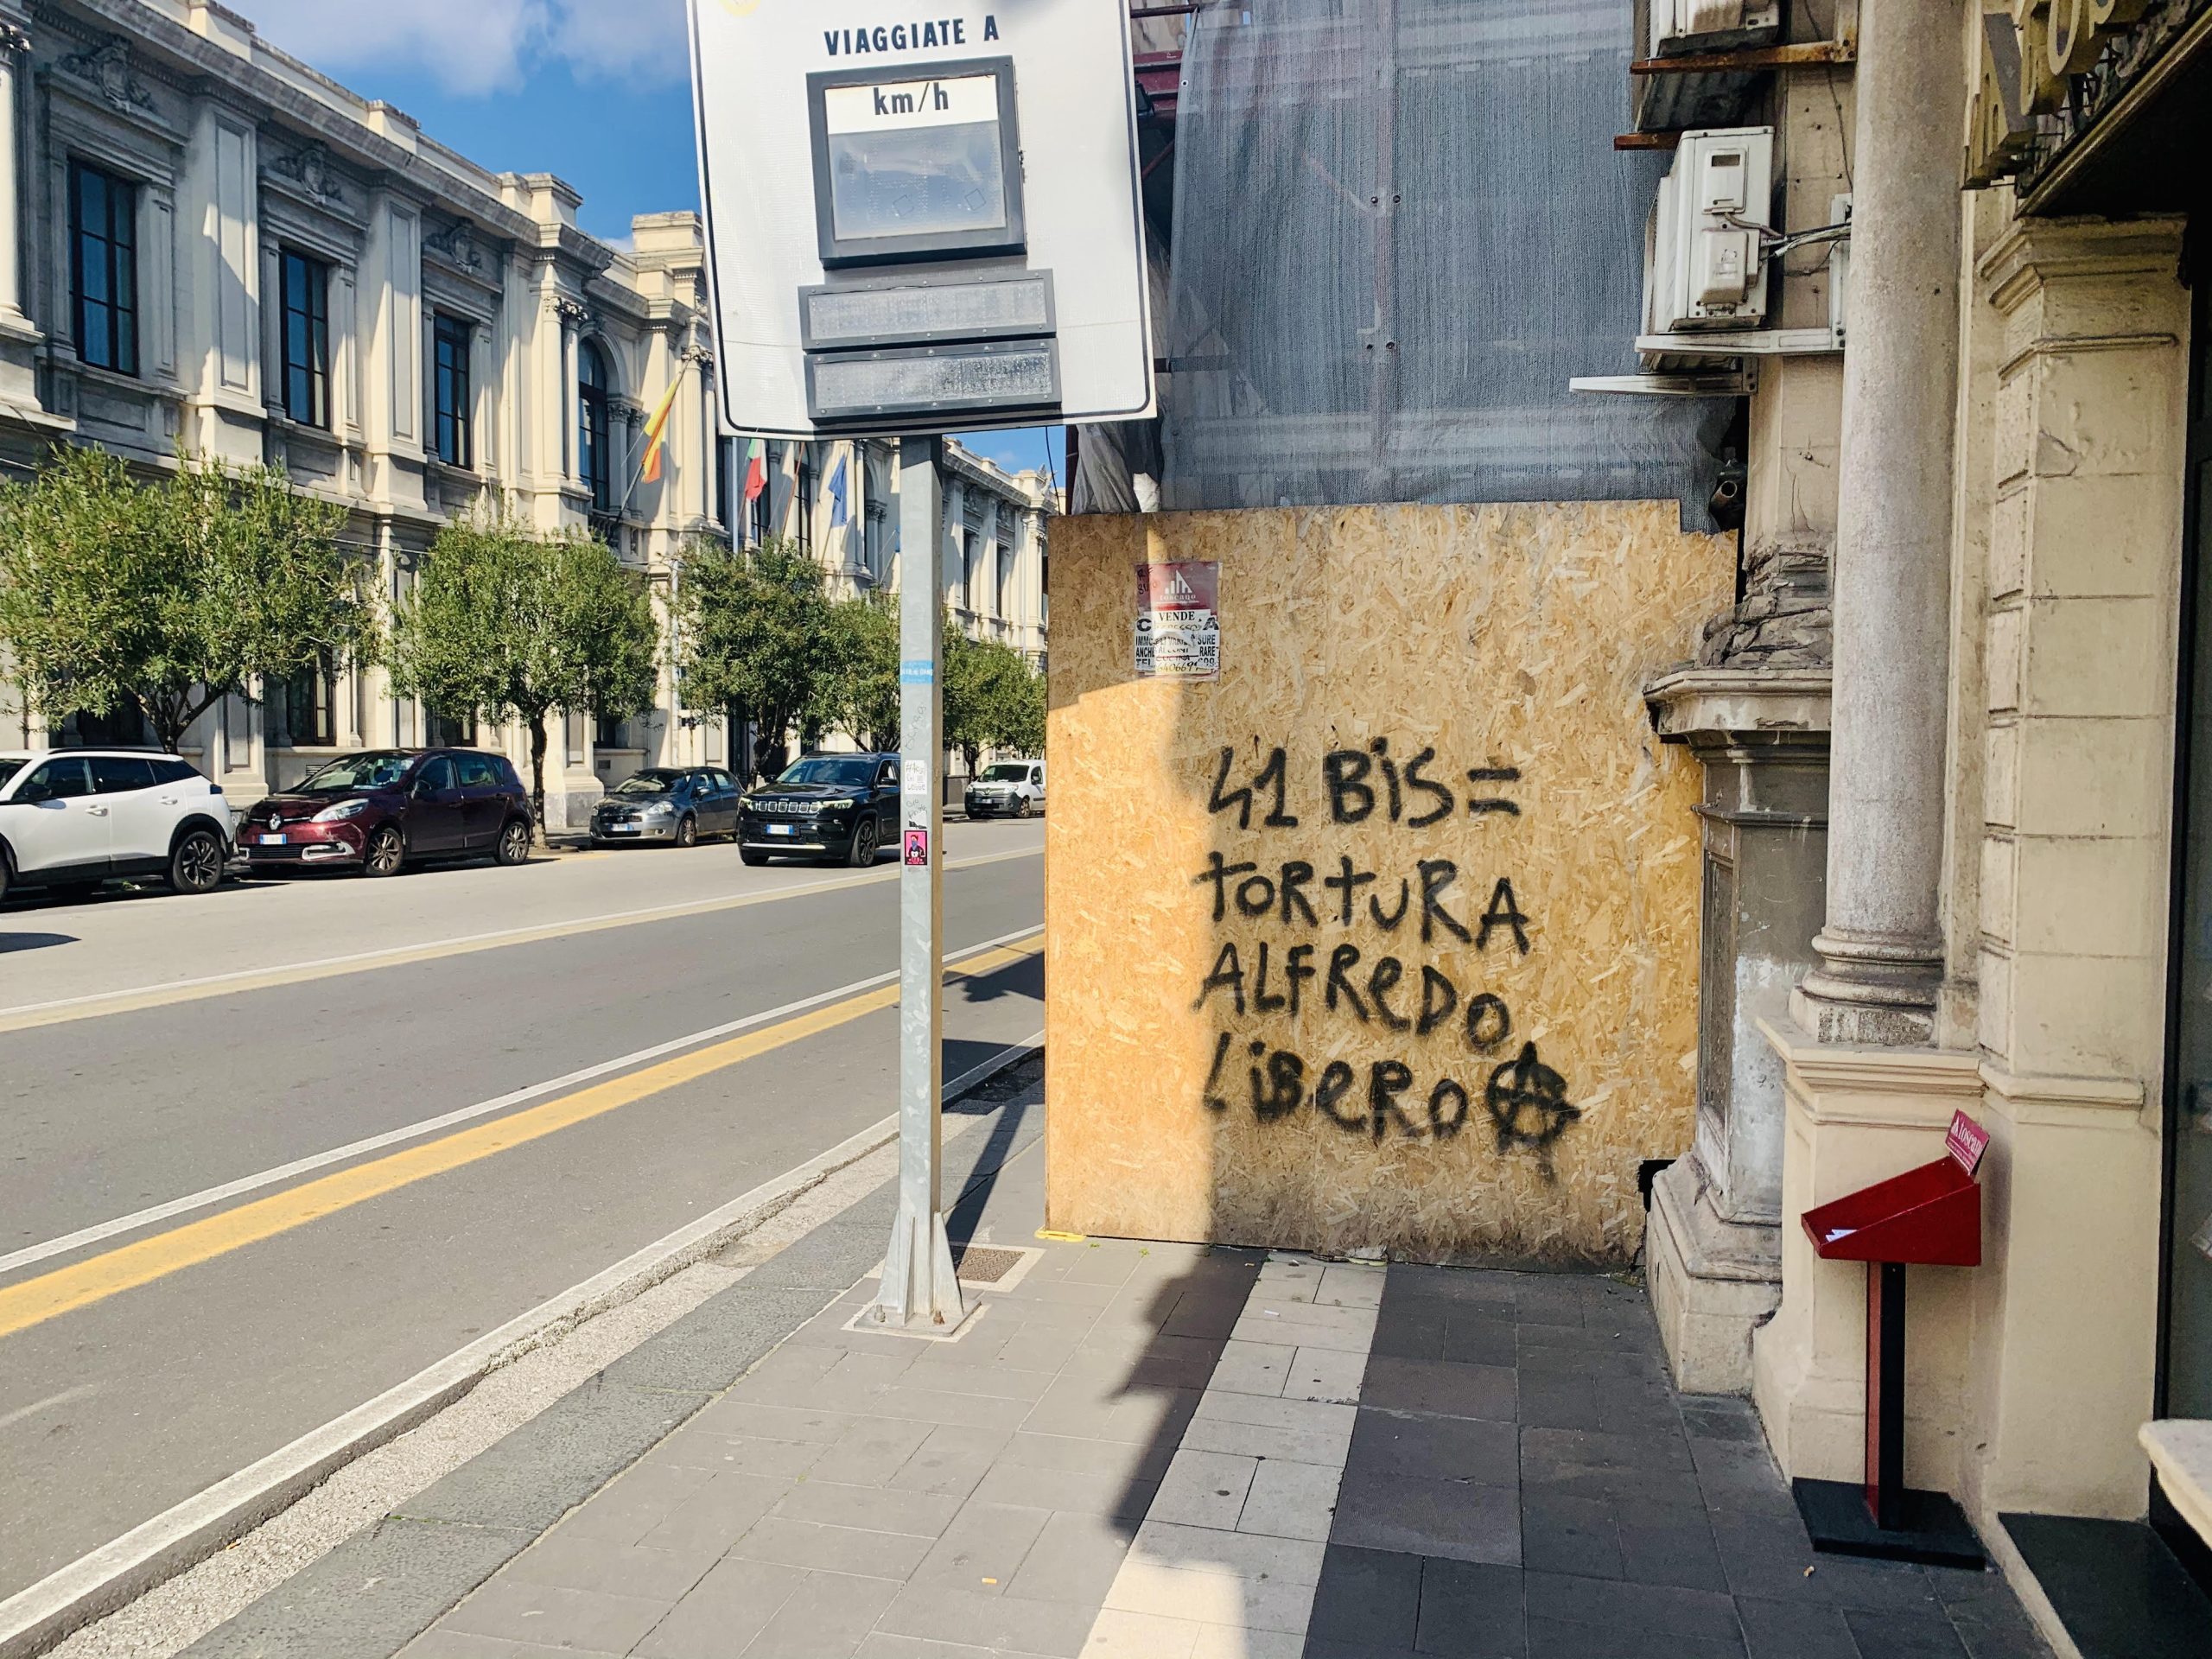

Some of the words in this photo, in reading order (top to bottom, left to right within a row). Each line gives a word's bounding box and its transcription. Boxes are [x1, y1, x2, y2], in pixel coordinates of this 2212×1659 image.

[823, 18, 966, 56] VIAGGIATE
[983, 15, 1000, 41] A
[873, 81, 950, 116] km/h
[1159, 611, 1195, 621] VENDE
[1199, 645, 1216, 657] RARE
